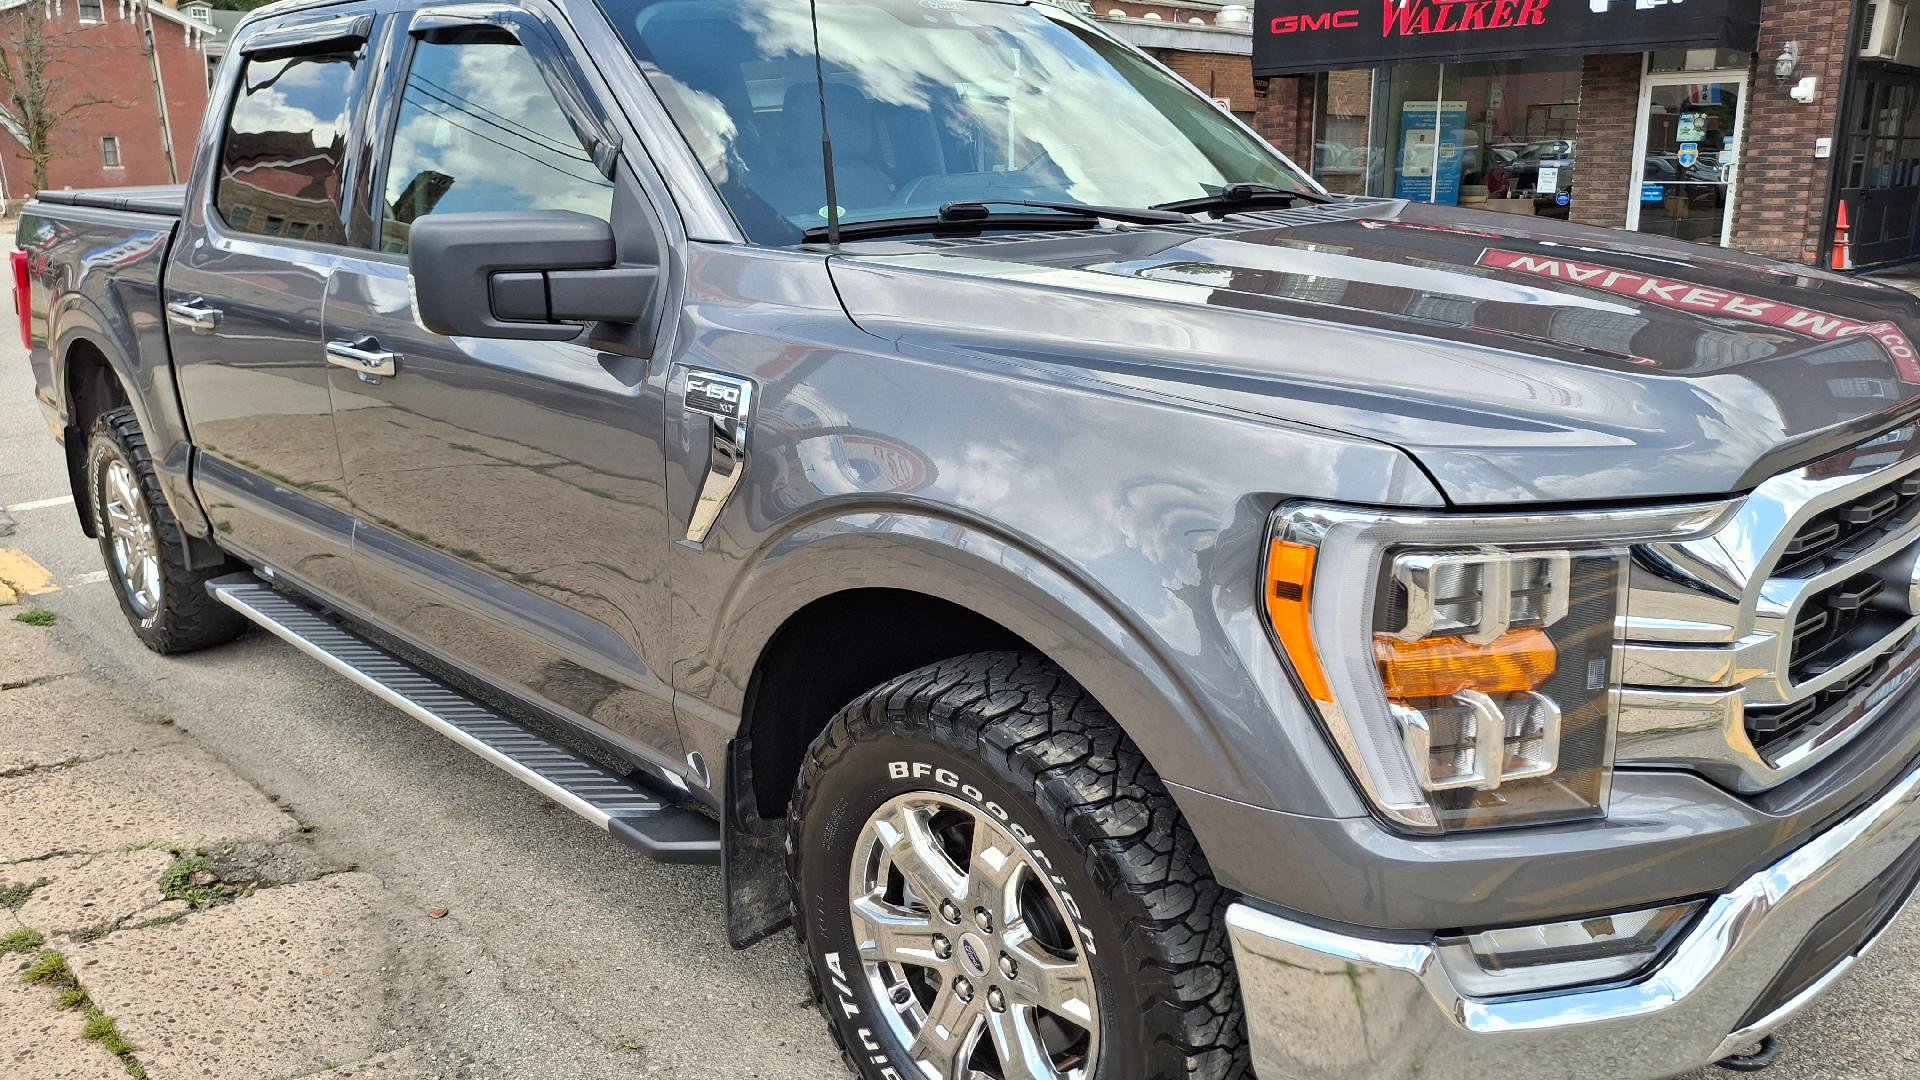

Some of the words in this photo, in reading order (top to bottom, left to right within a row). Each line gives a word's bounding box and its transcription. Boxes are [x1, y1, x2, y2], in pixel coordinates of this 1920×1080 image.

[1271, 10, 1359, 34] GMC
[1382, 0, 1550, 37] WALKER
[687, 380, 740, 403] F-150
[719, 402, 735, 413] XLT
[888, 761, 1097, 955] BFGoodrich
[825, 952, 860, 1020] T/A
